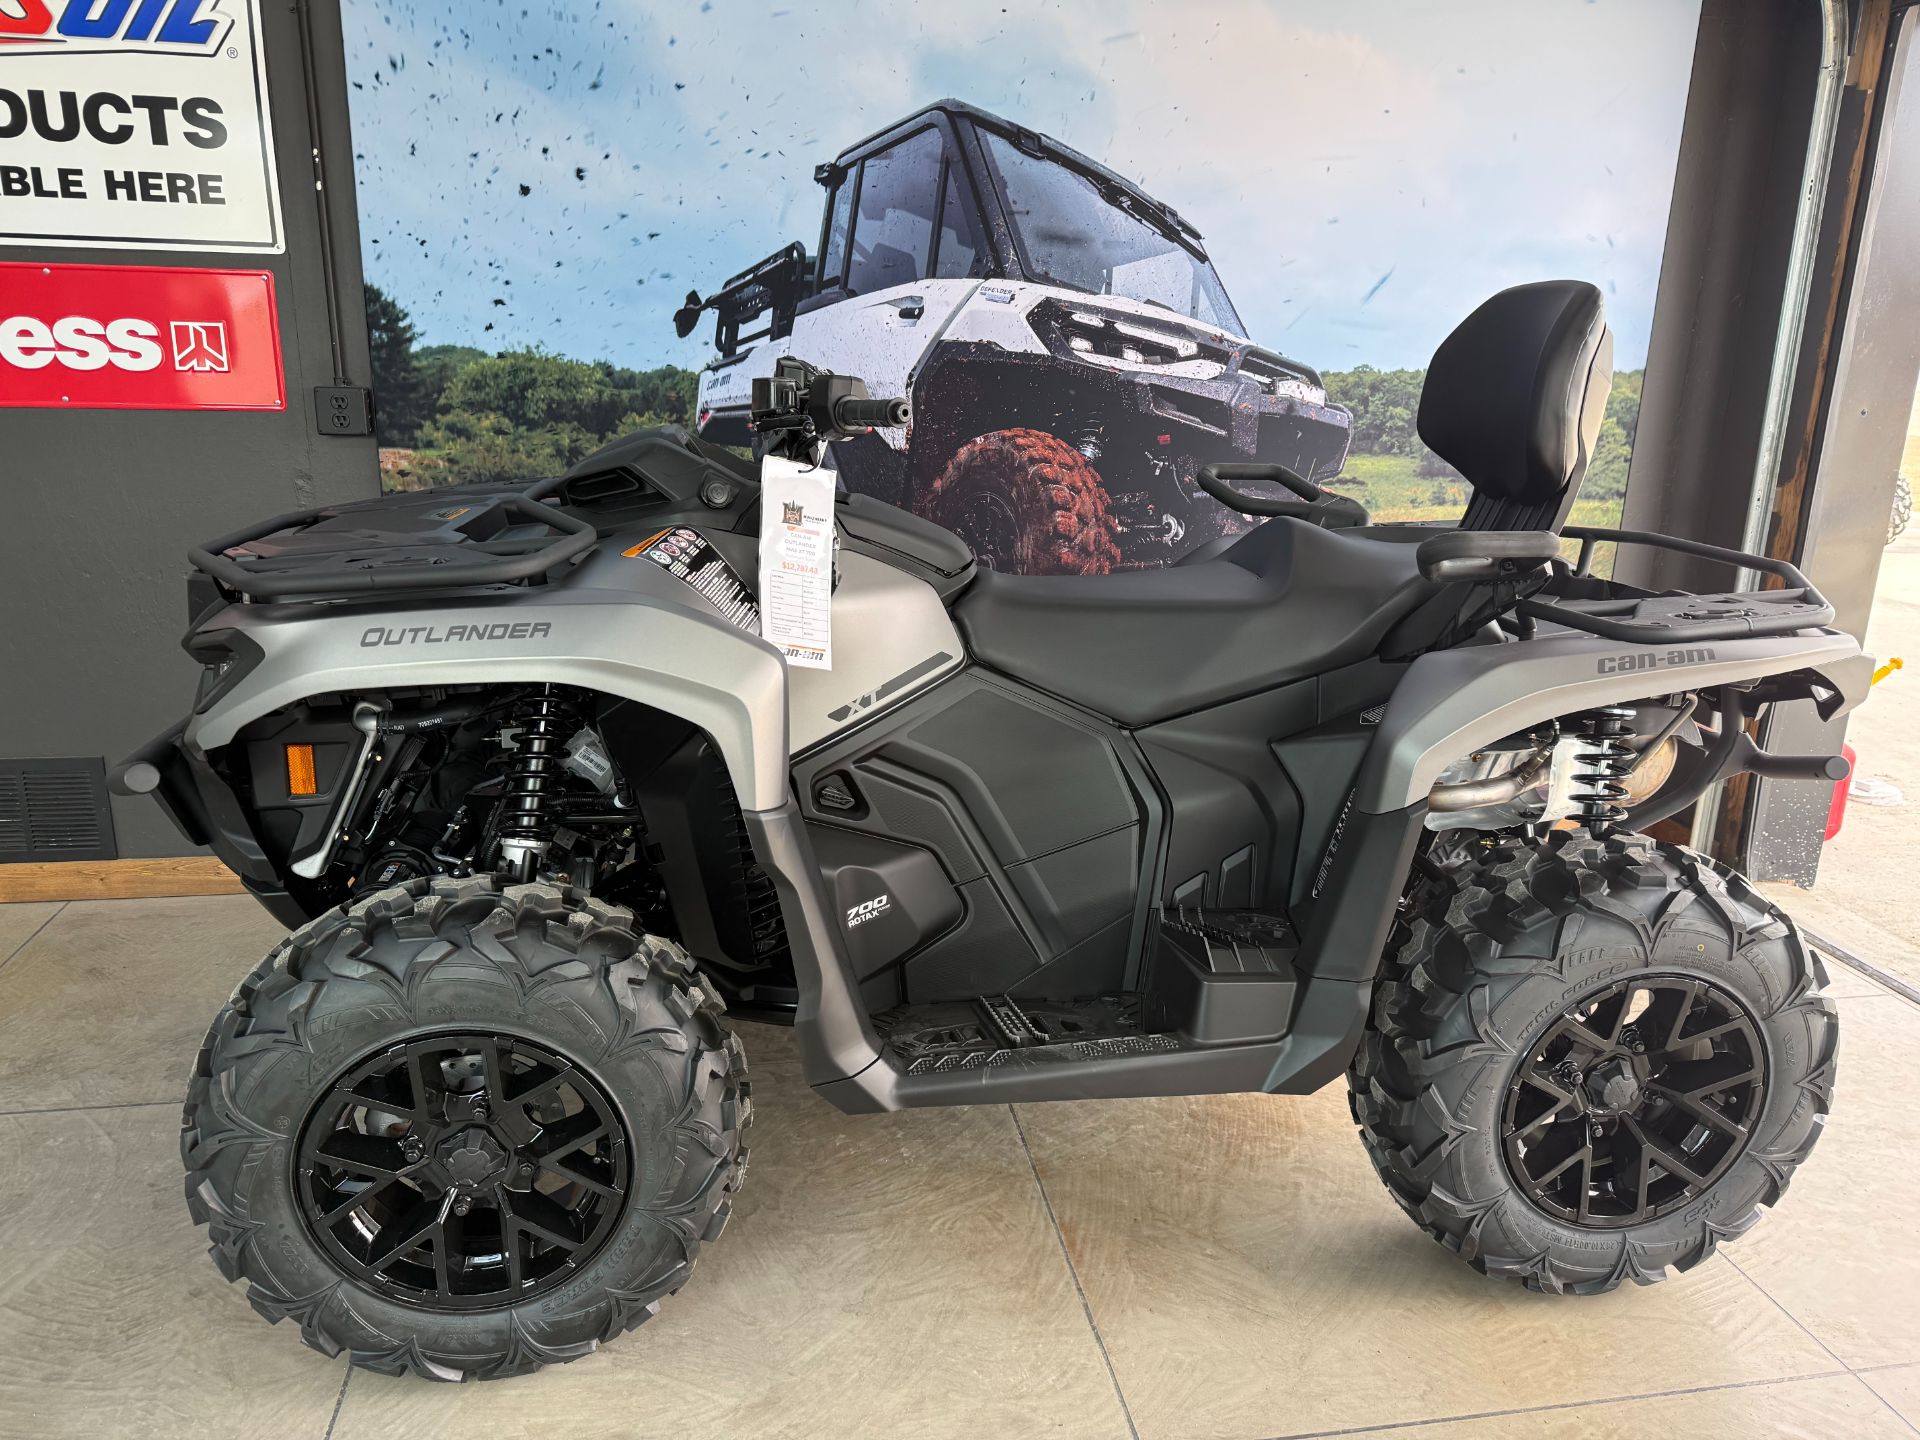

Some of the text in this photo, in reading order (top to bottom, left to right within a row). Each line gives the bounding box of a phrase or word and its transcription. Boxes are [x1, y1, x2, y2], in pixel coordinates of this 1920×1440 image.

[104, 169, 226, 205] HERE
[0, 316, 162, 371] ess
[360, 622, 552, 648] OUTLANDER
[783, 647, 825, 661] an-am
[1597, 647, 1716, 674] can-am
[846, 686, 882, 718] XT
[847, 894, 888, 921] 700
[848, 909, 880, 928] ROTAX
